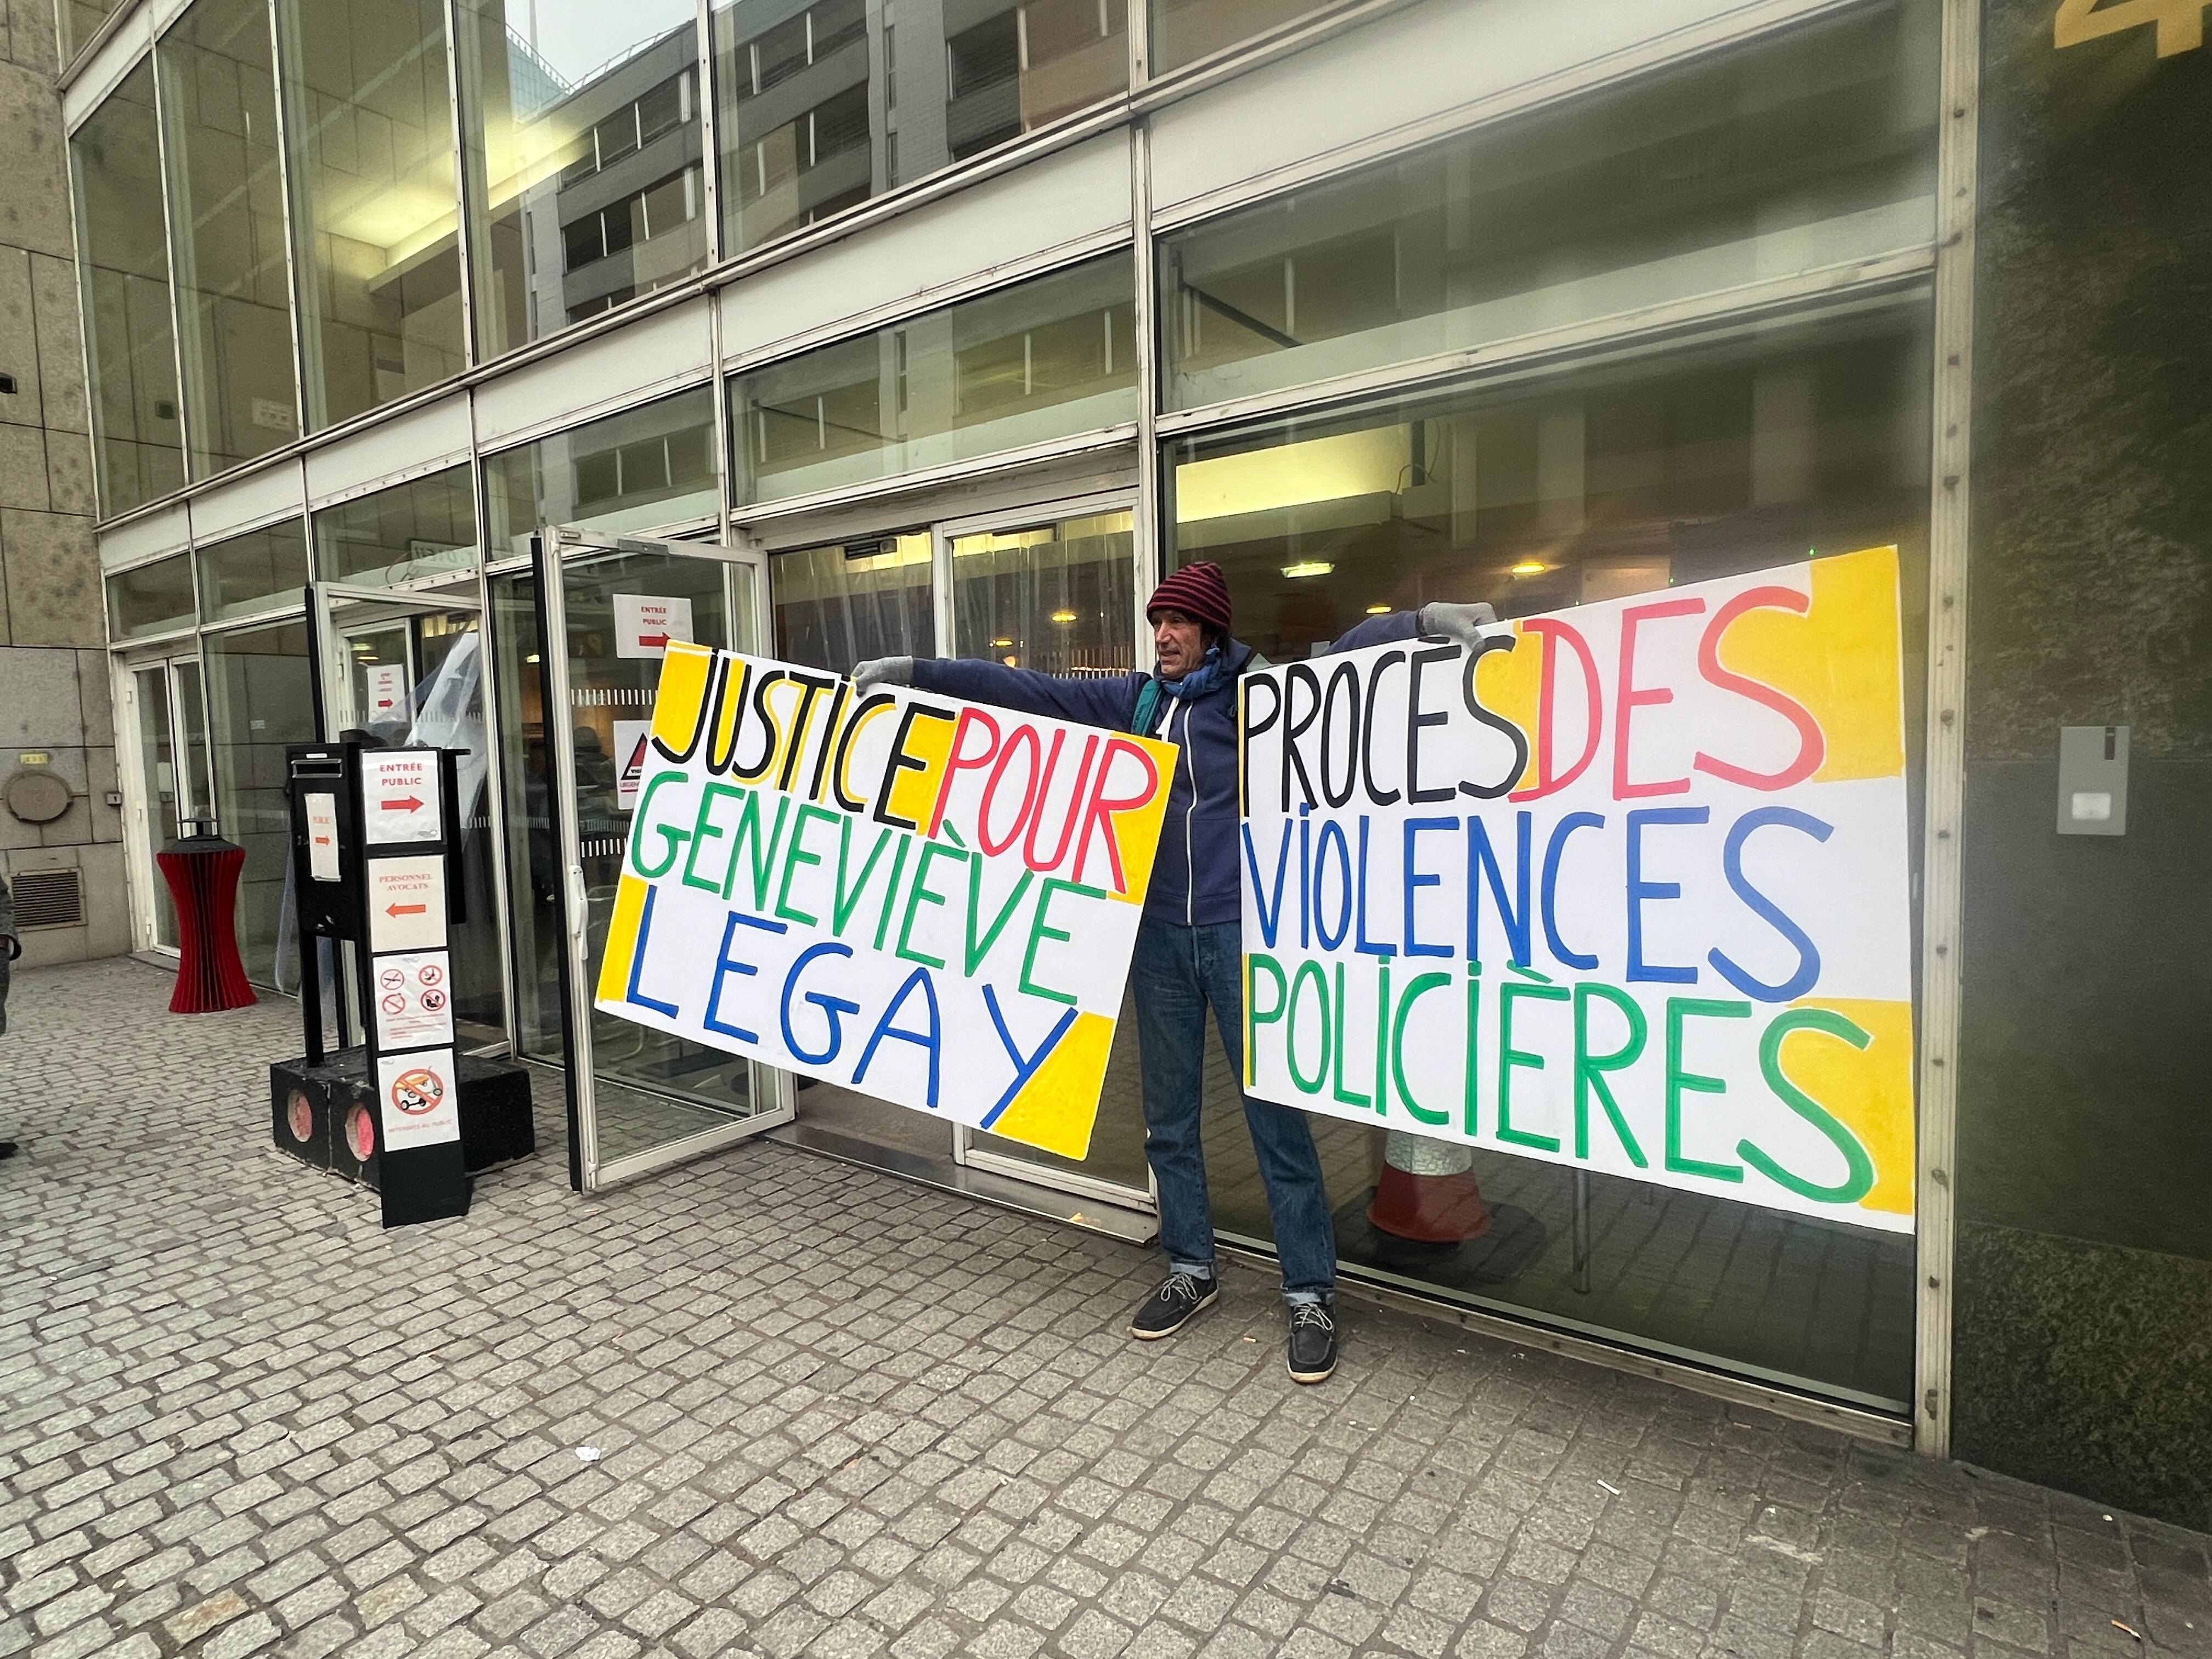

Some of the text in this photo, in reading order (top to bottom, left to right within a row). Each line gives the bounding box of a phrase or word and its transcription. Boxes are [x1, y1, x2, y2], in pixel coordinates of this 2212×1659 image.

[641, 606, 667, 614] ENTRÉE
[1508, 585, 1826, 803] DES
[379, 762, 422, 772] ENTRÉE
[651, 646, 1158, 894] JUSTICE POUR
[381, 777, 422, 786] PUBLIC
[379, 873, 433, 883] PERSONNEL
[387, 883, 429, 891] AVOCATS
[631, 771, 1107, 1005] GENEVIÈVE
[627, 885, 1078, 1131] LEGAY
